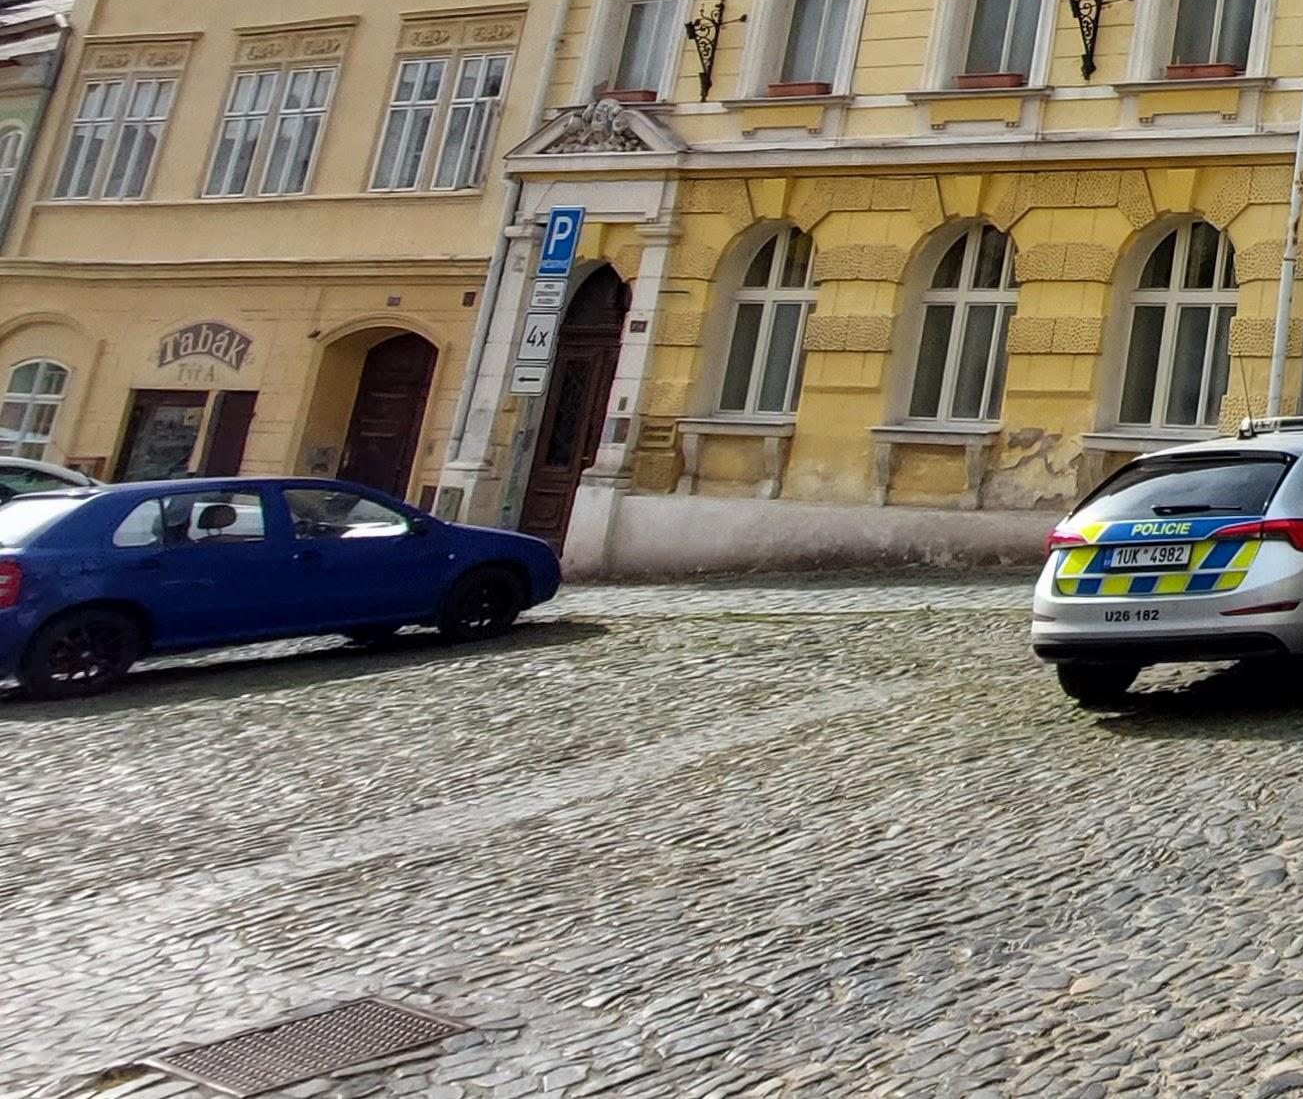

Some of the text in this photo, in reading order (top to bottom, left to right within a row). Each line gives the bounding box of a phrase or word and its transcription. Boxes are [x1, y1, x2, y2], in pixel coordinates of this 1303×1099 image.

[547, 216, 573, 255] P
[162, 324, 247, 367] Tabák
[1131, 522, 1192, 537] POLICIE
[1116, 548, 1138, 565] 1UK
[1150, 546, 1184, 563] 4982
[1105, 609, 1160, 622] U26 182
